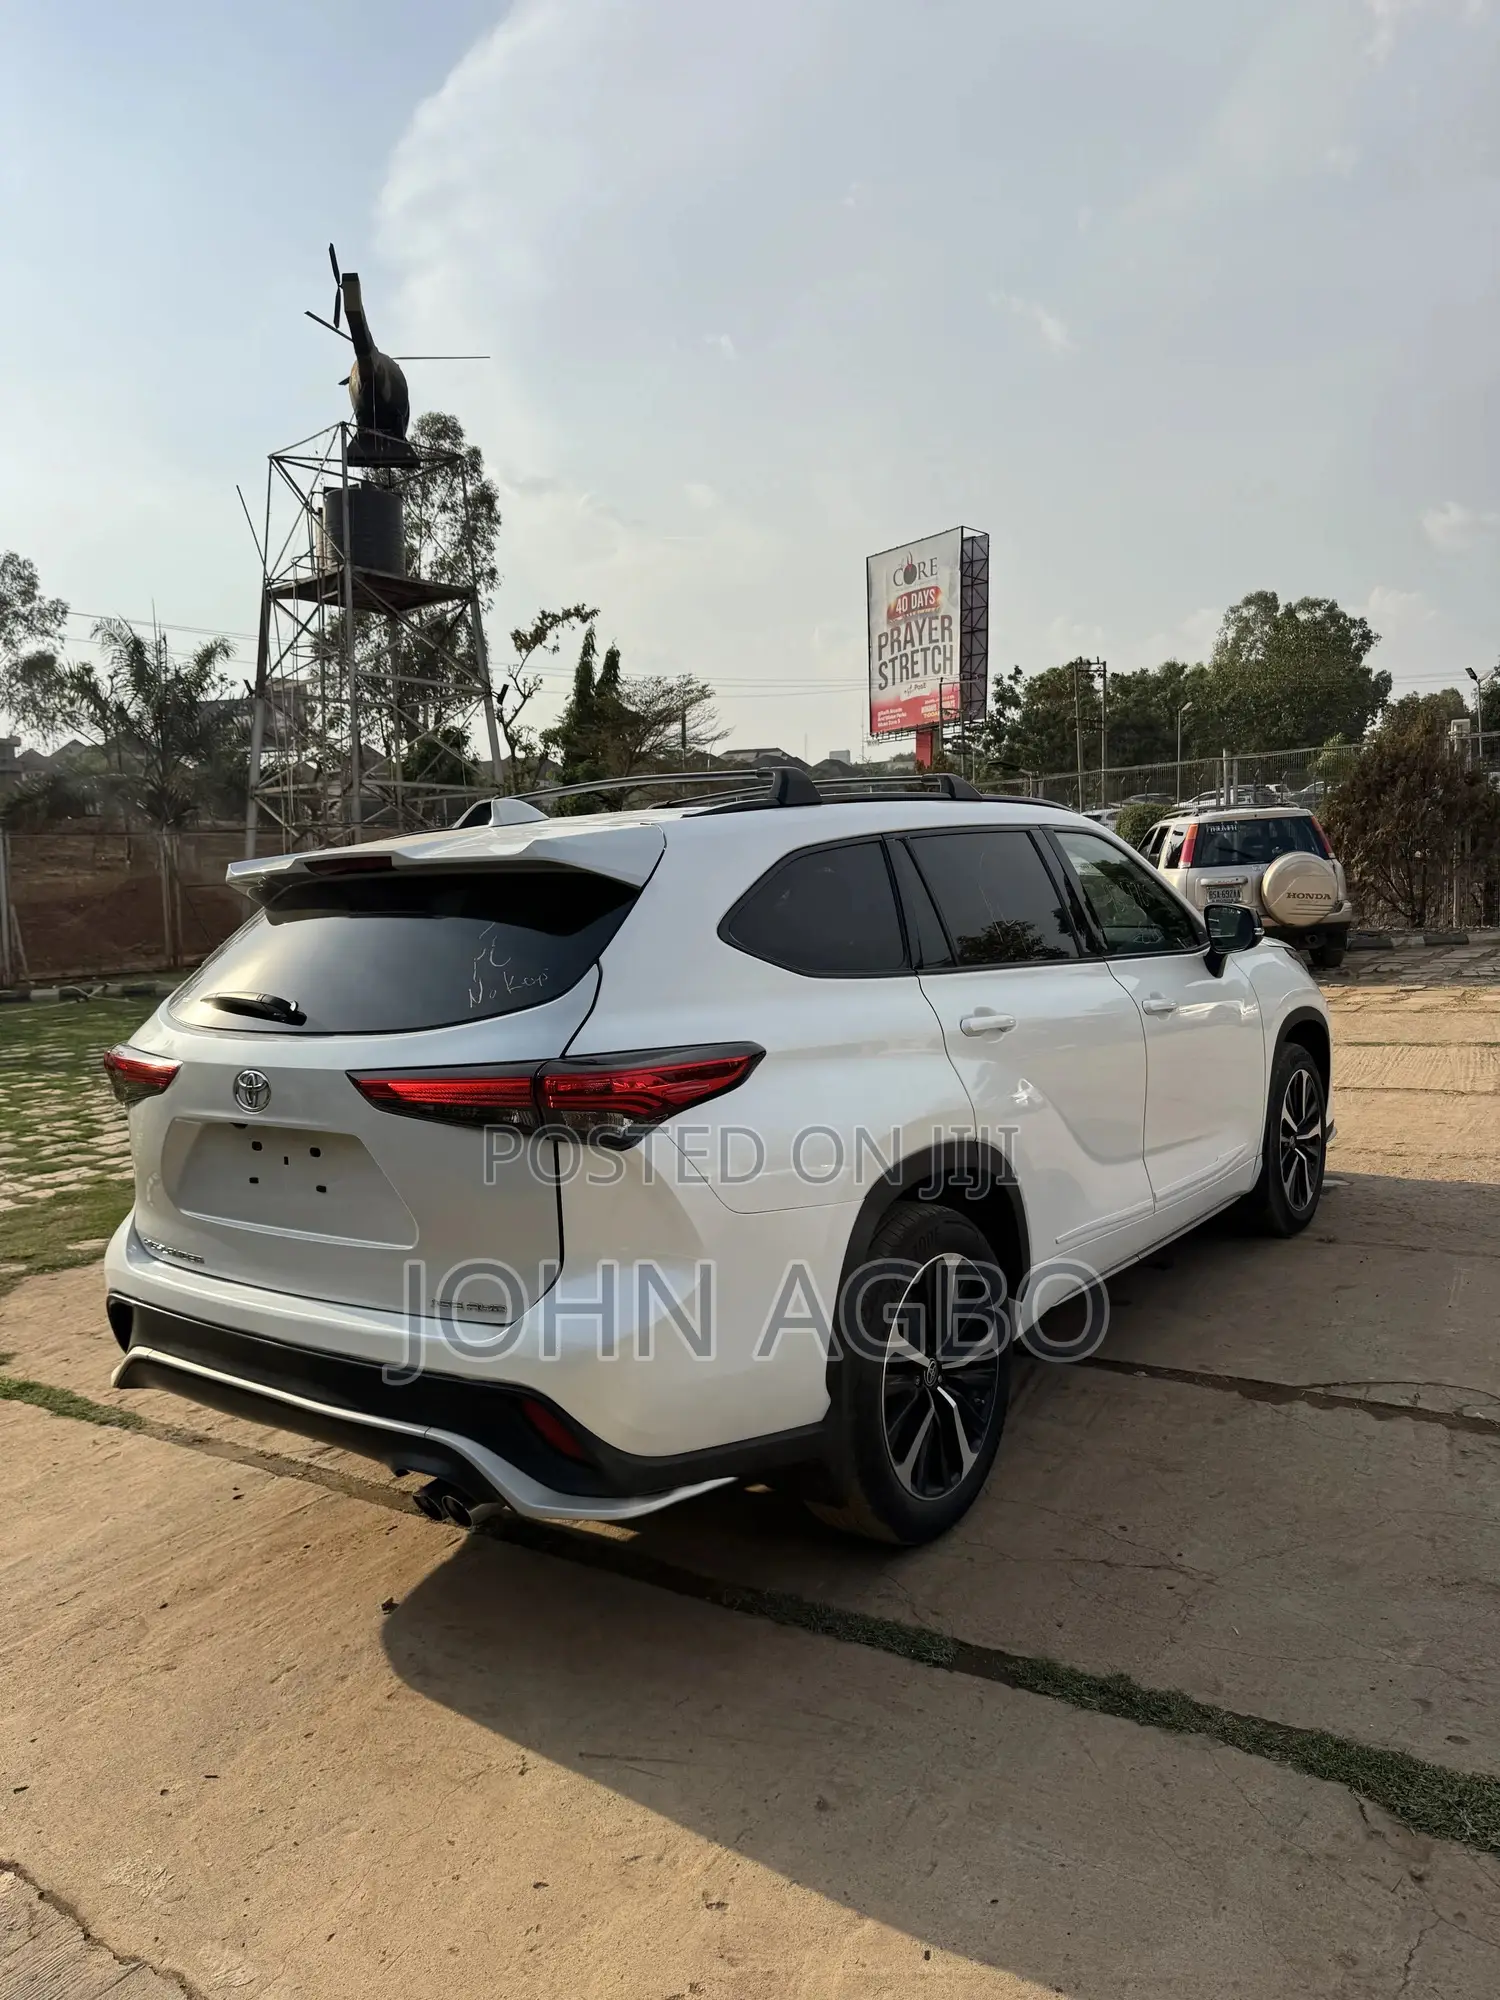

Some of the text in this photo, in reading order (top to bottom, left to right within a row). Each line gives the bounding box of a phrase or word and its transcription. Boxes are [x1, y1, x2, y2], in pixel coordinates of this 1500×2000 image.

[893, 557, 938, 587] CORE
[896, 596, 908, 614] 40
[911, 588, 935, 609] DAYS
[878, 615, 953, 661] PRAYER
[878, 645, 953, 690] STRETCH
[1286, 892, 1332, 900] HONDA
